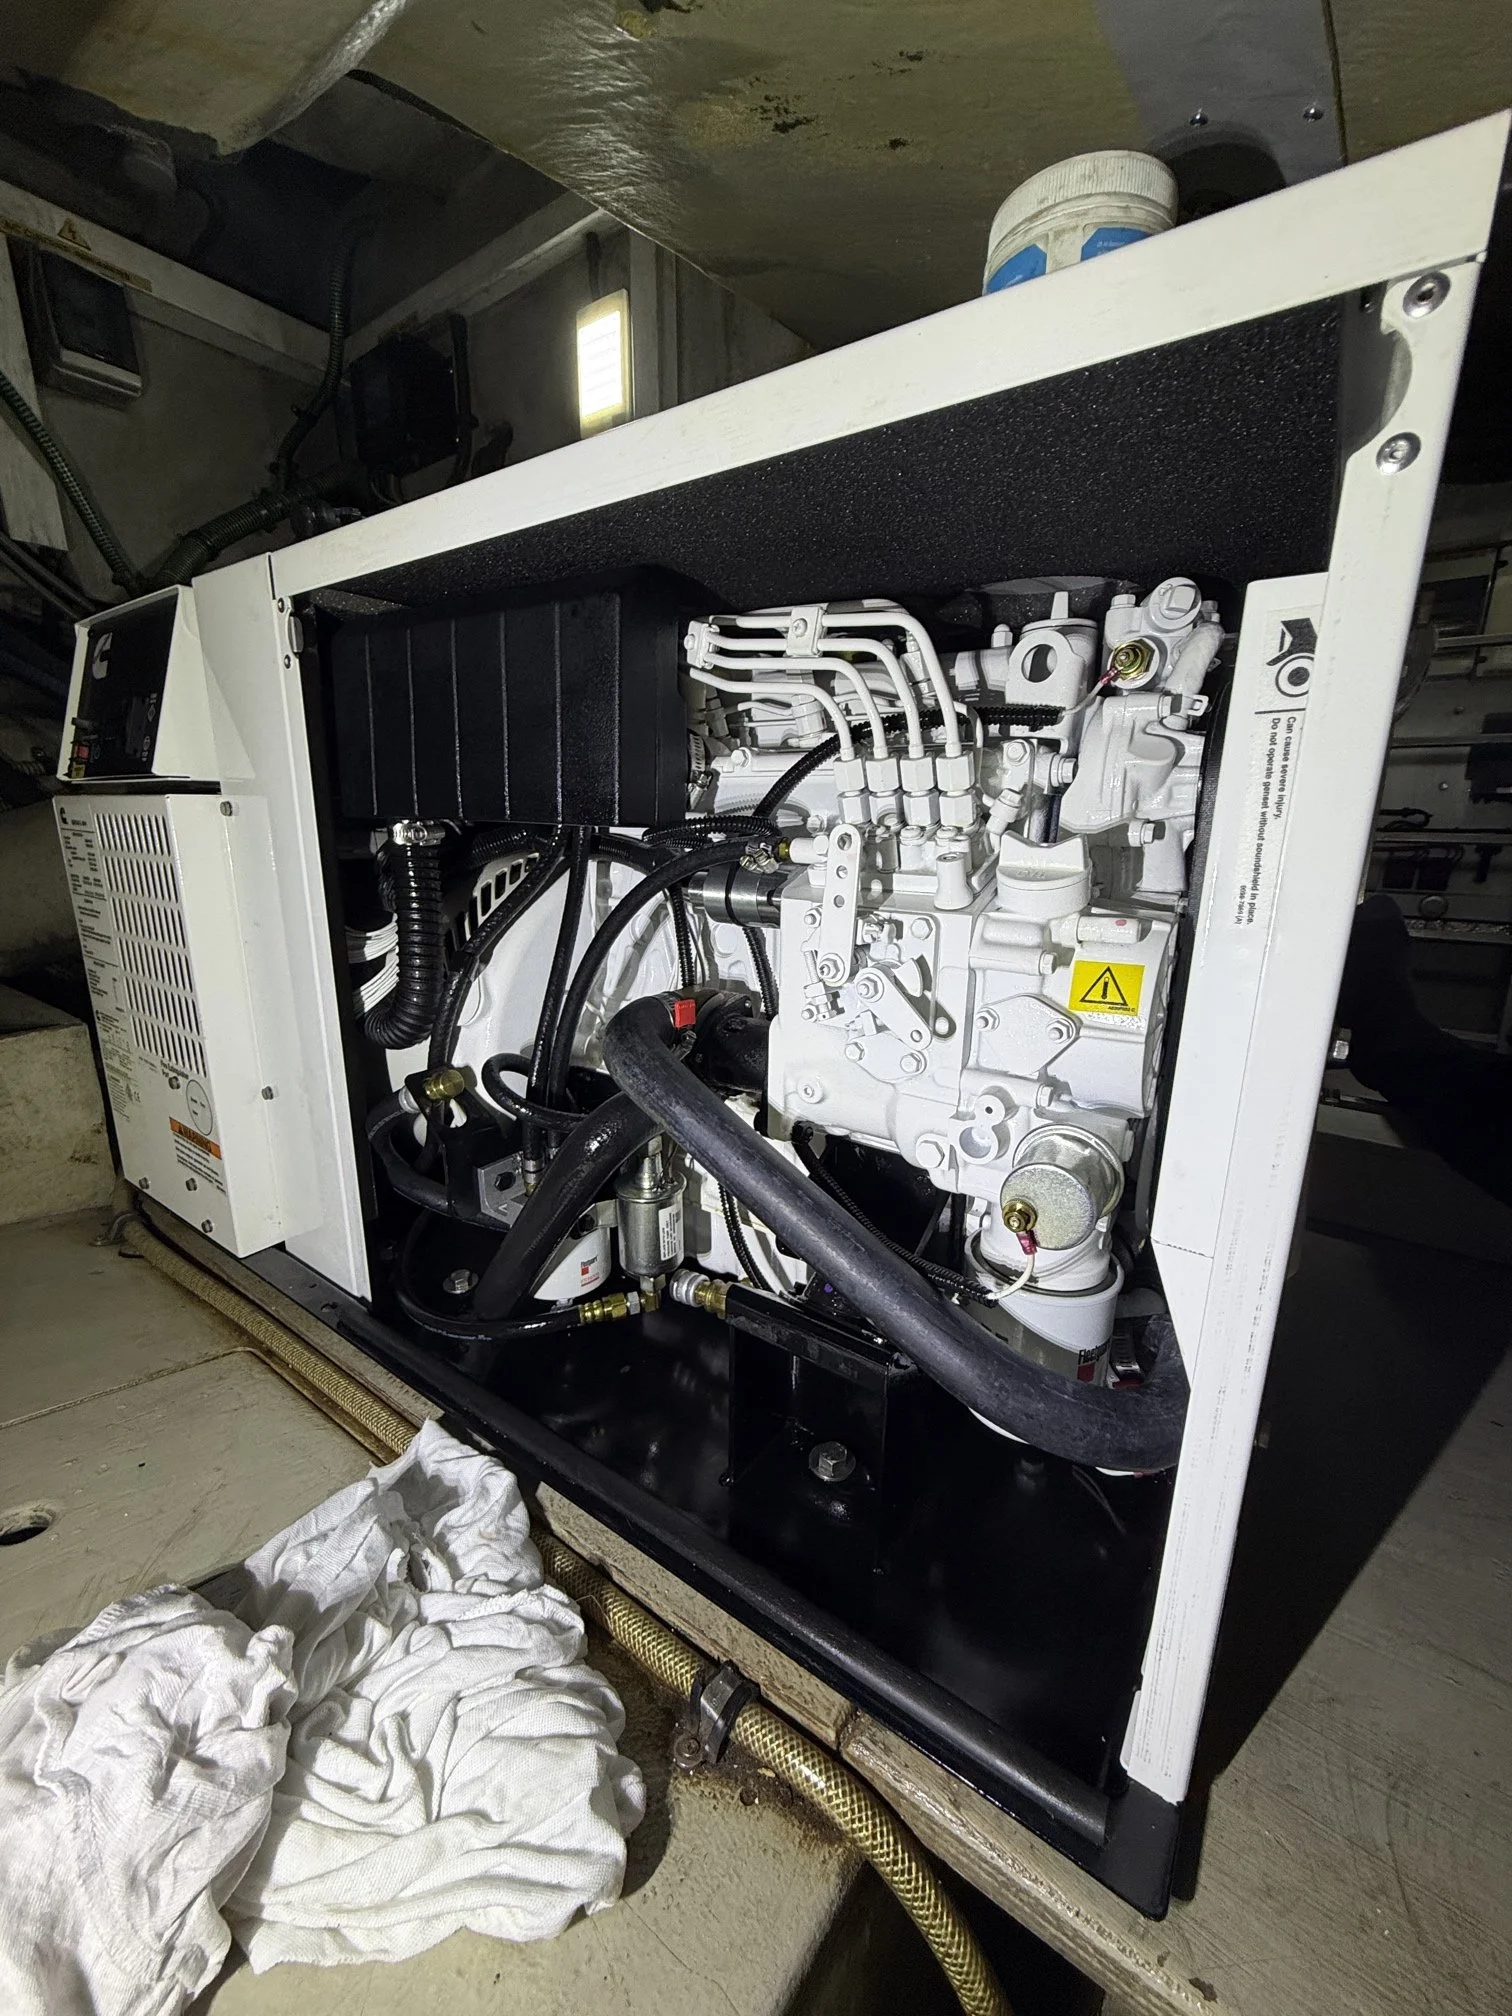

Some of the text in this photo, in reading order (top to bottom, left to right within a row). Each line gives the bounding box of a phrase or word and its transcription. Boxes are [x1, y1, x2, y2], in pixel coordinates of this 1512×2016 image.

[1246, 717, 1281, 925] Do not operate genset without soundshield in place.
[1273, 716, 1297, 820] Can cause severe injury.
